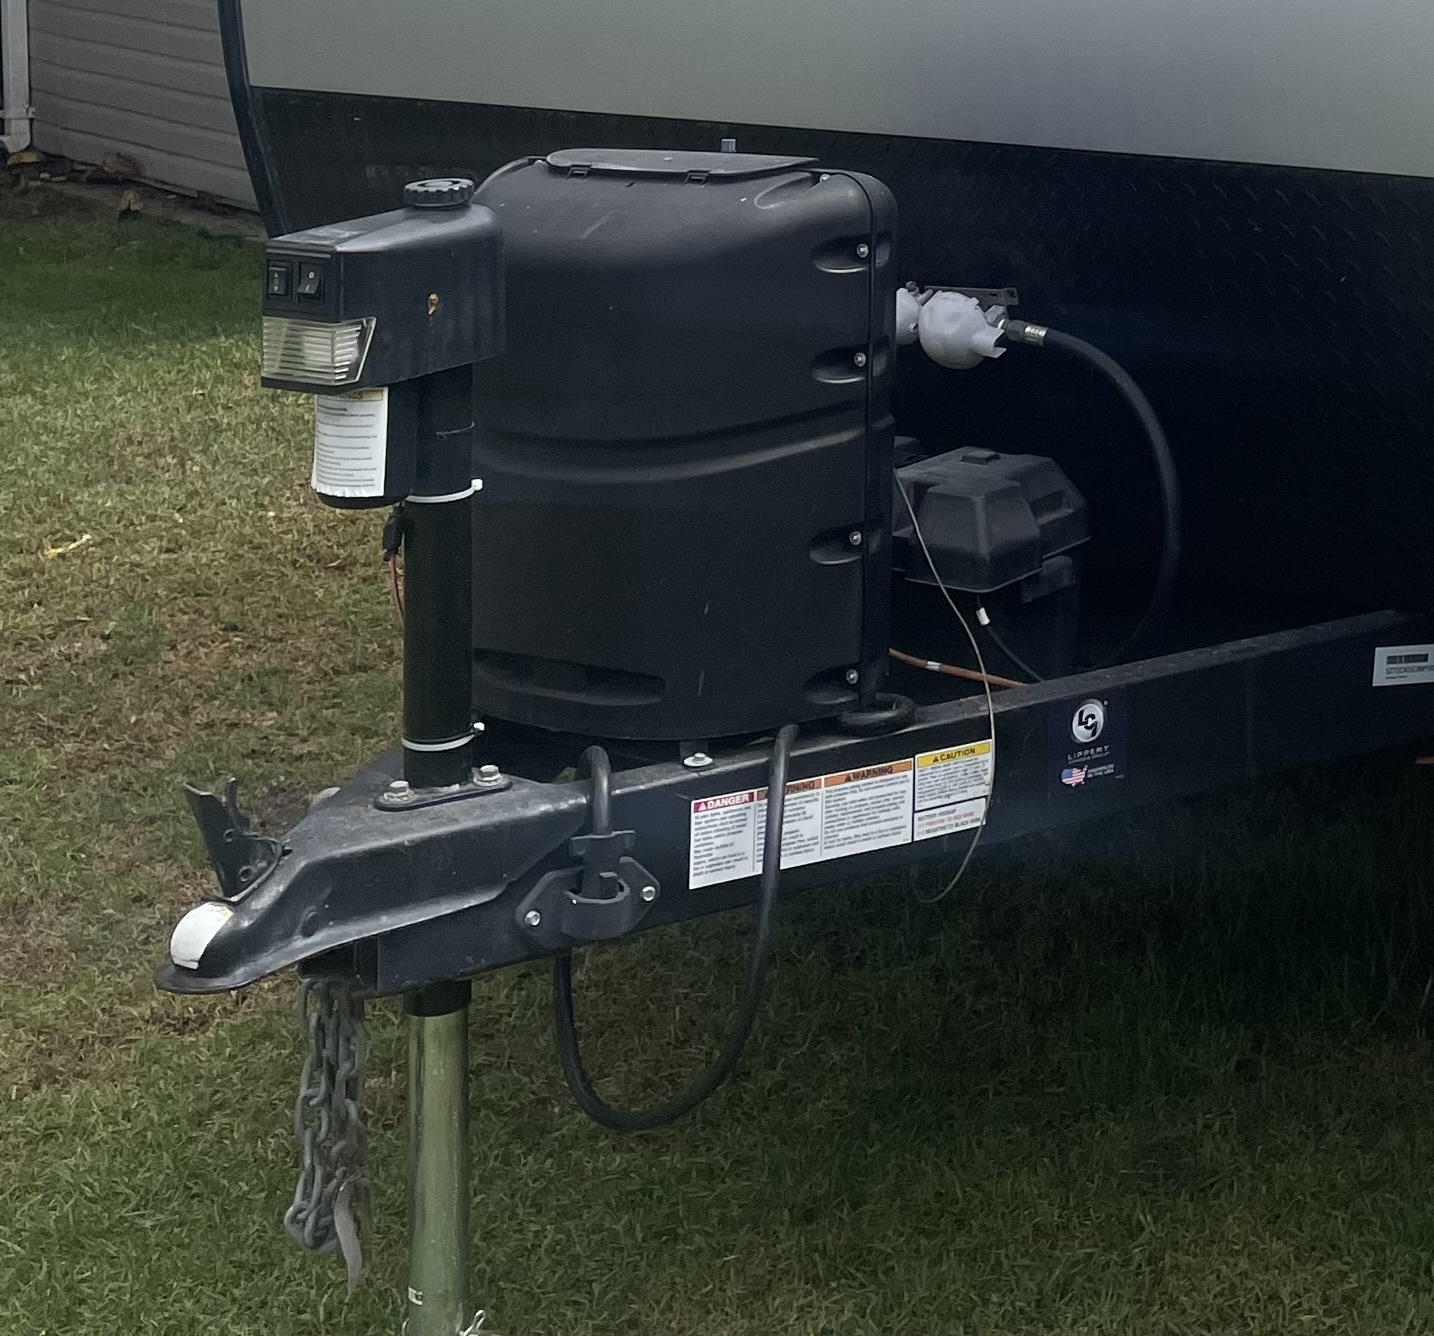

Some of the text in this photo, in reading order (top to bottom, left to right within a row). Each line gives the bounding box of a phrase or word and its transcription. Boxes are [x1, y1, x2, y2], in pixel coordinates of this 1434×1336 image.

[939, 747, 976, 762] CAUTION
[1067, 745, 1109, 761] LIPPERT
[852, 765, 893, 780] WARNING
[706, 793, 750, 810] DANGER
